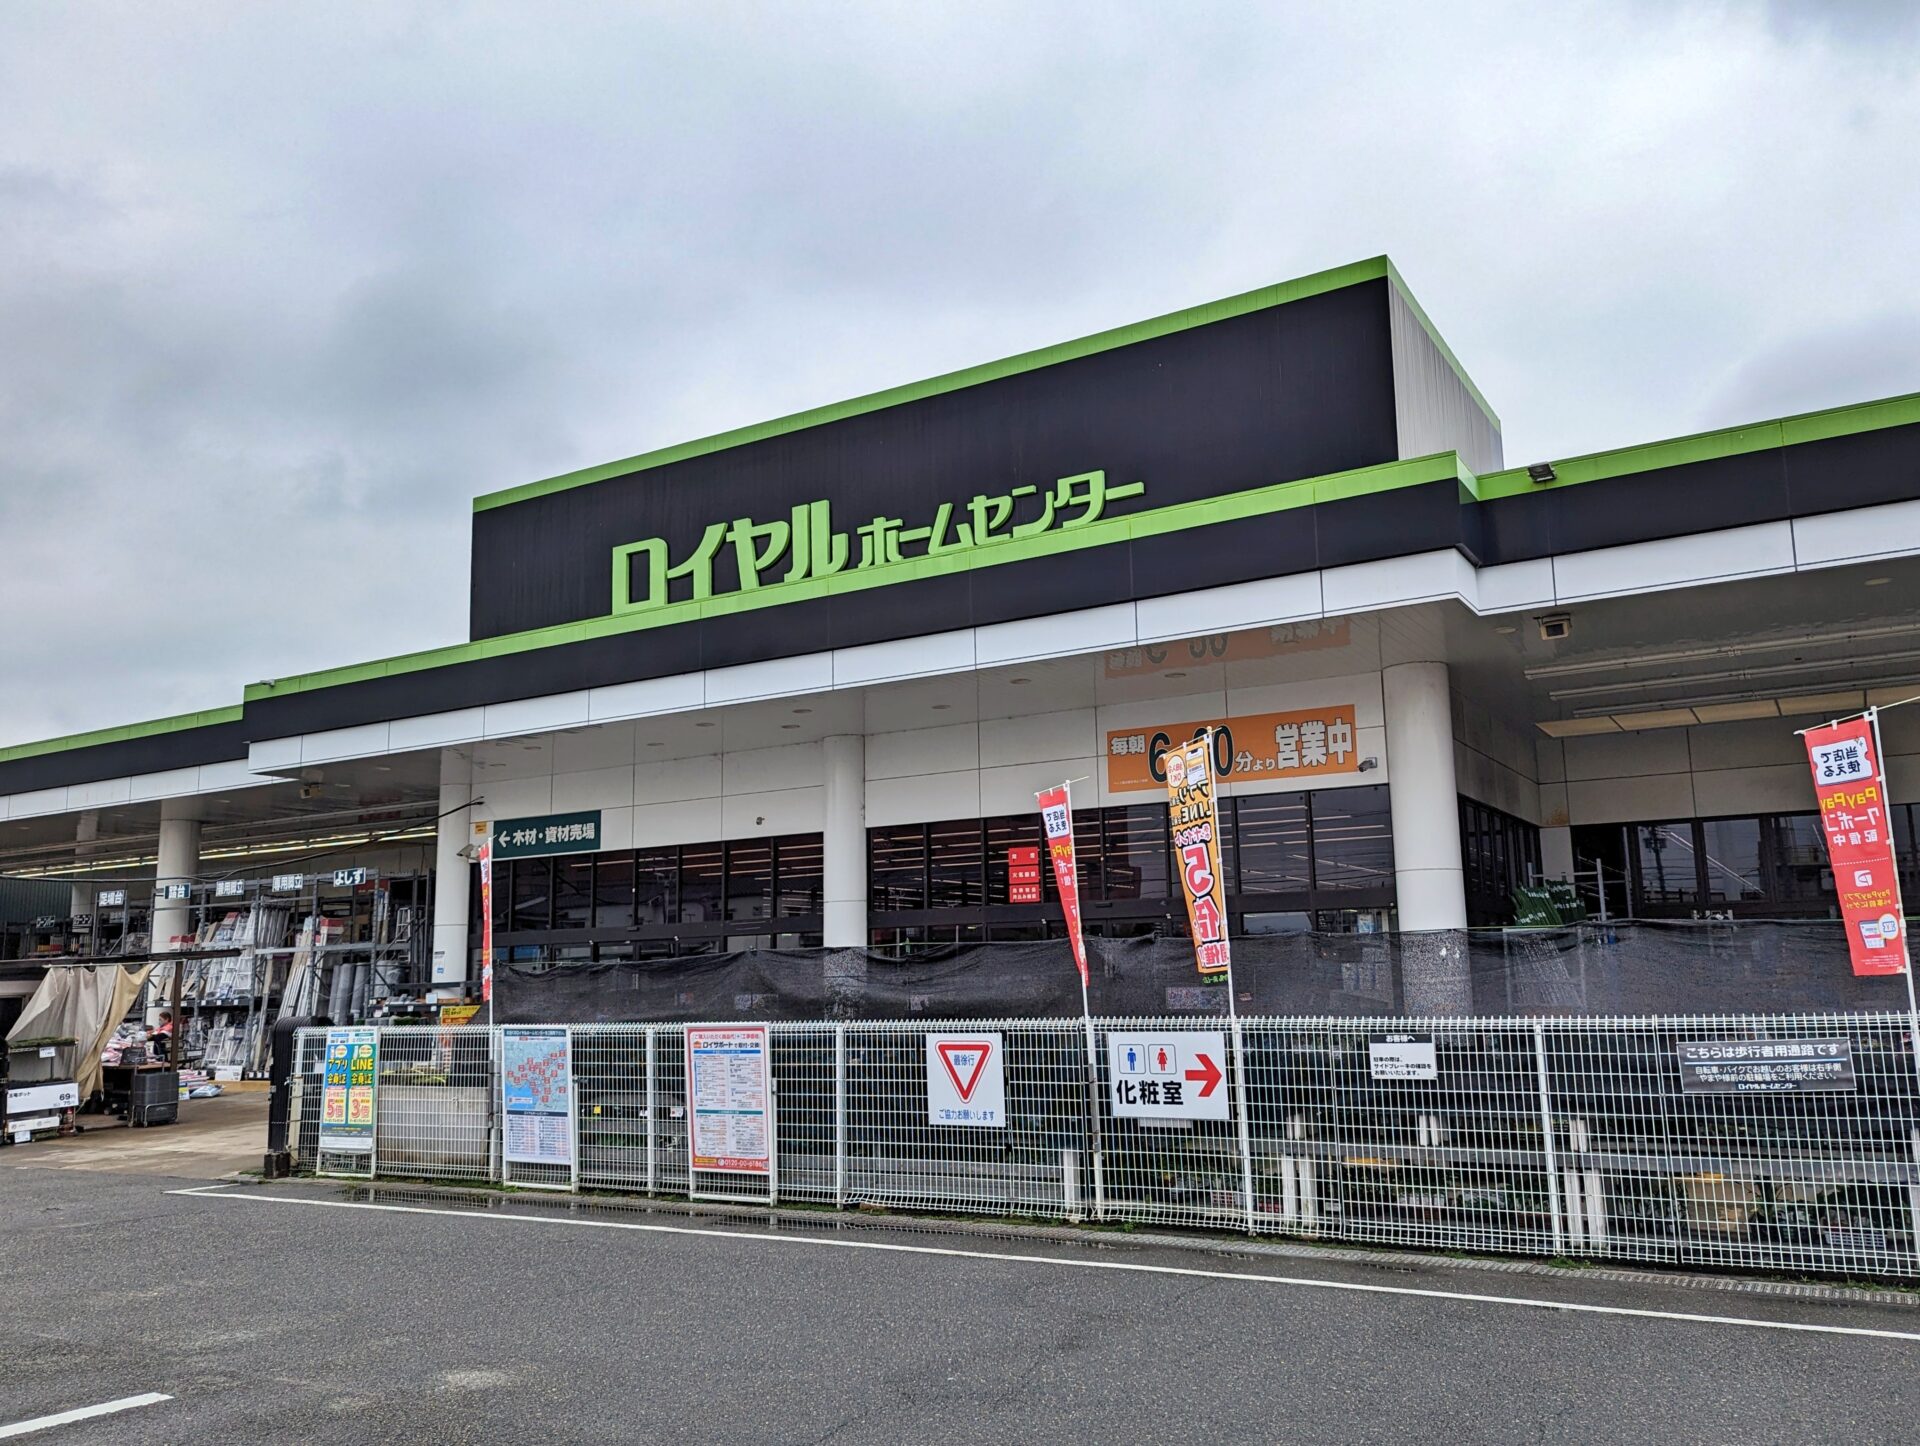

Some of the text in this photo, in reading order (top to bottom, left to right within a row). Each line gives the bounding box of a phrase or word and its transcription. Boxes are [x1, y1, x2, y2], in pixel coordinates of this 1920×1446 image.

[1110, 733, 1145, 756] 毎朝
[1275, 718, 1353, 770] 営業中
[512, 822, 595, 846] 木材・資材売場
[334, 869, 365, 885] よしず
[1386, 1034, 1415, 1043] お客様へ
[1686, 1043, 1840, 1059] こちらは歩行者用通路です
[350, 1058, 374, 1071] LINE
[954, 1054, 975, 1066] 最徐行
[1116, 1079, 1184, 1105] 化粧室
[939, 1108, 994, 1121] ご協力お願いします
